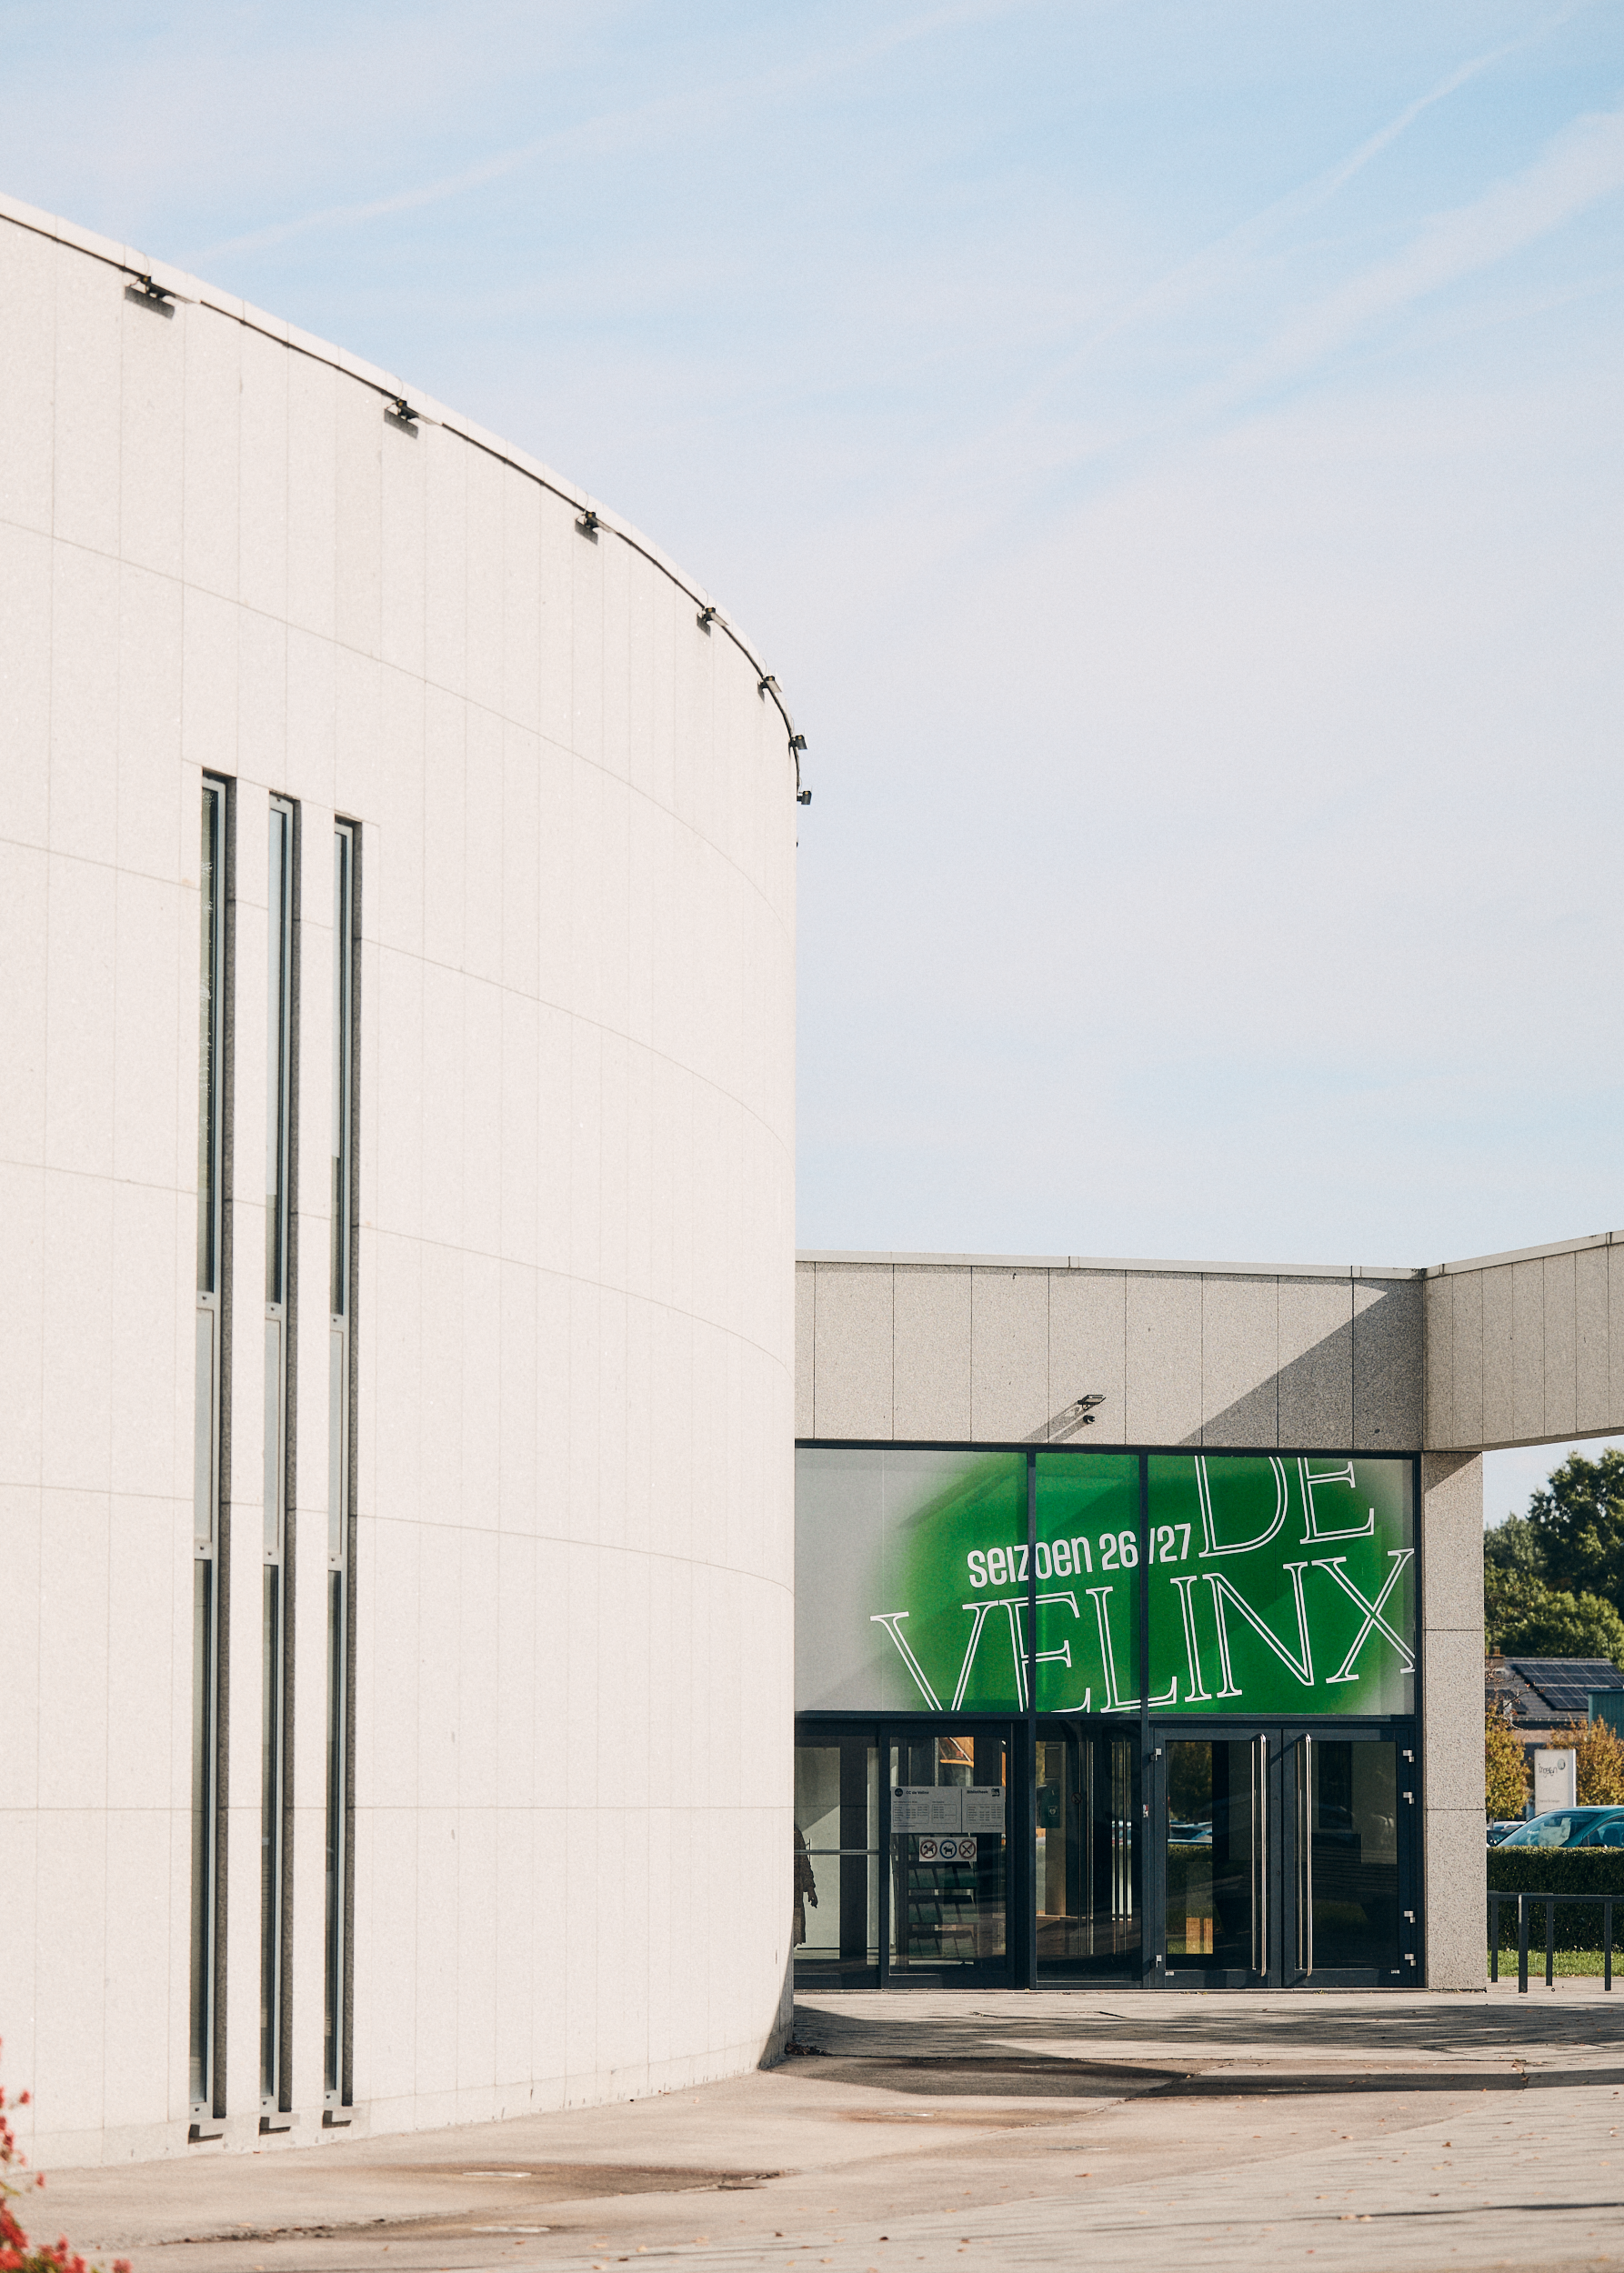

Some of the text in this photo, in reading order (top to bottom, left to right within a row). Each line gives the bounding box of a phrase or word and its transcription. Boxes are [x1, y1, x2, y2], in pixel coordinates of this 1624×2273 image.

[1194, 1456, 1375, 1557] DE
[967, 1536, 1093, 1588] seizoen
[870, 1547, 1416, 1714] VELINX
